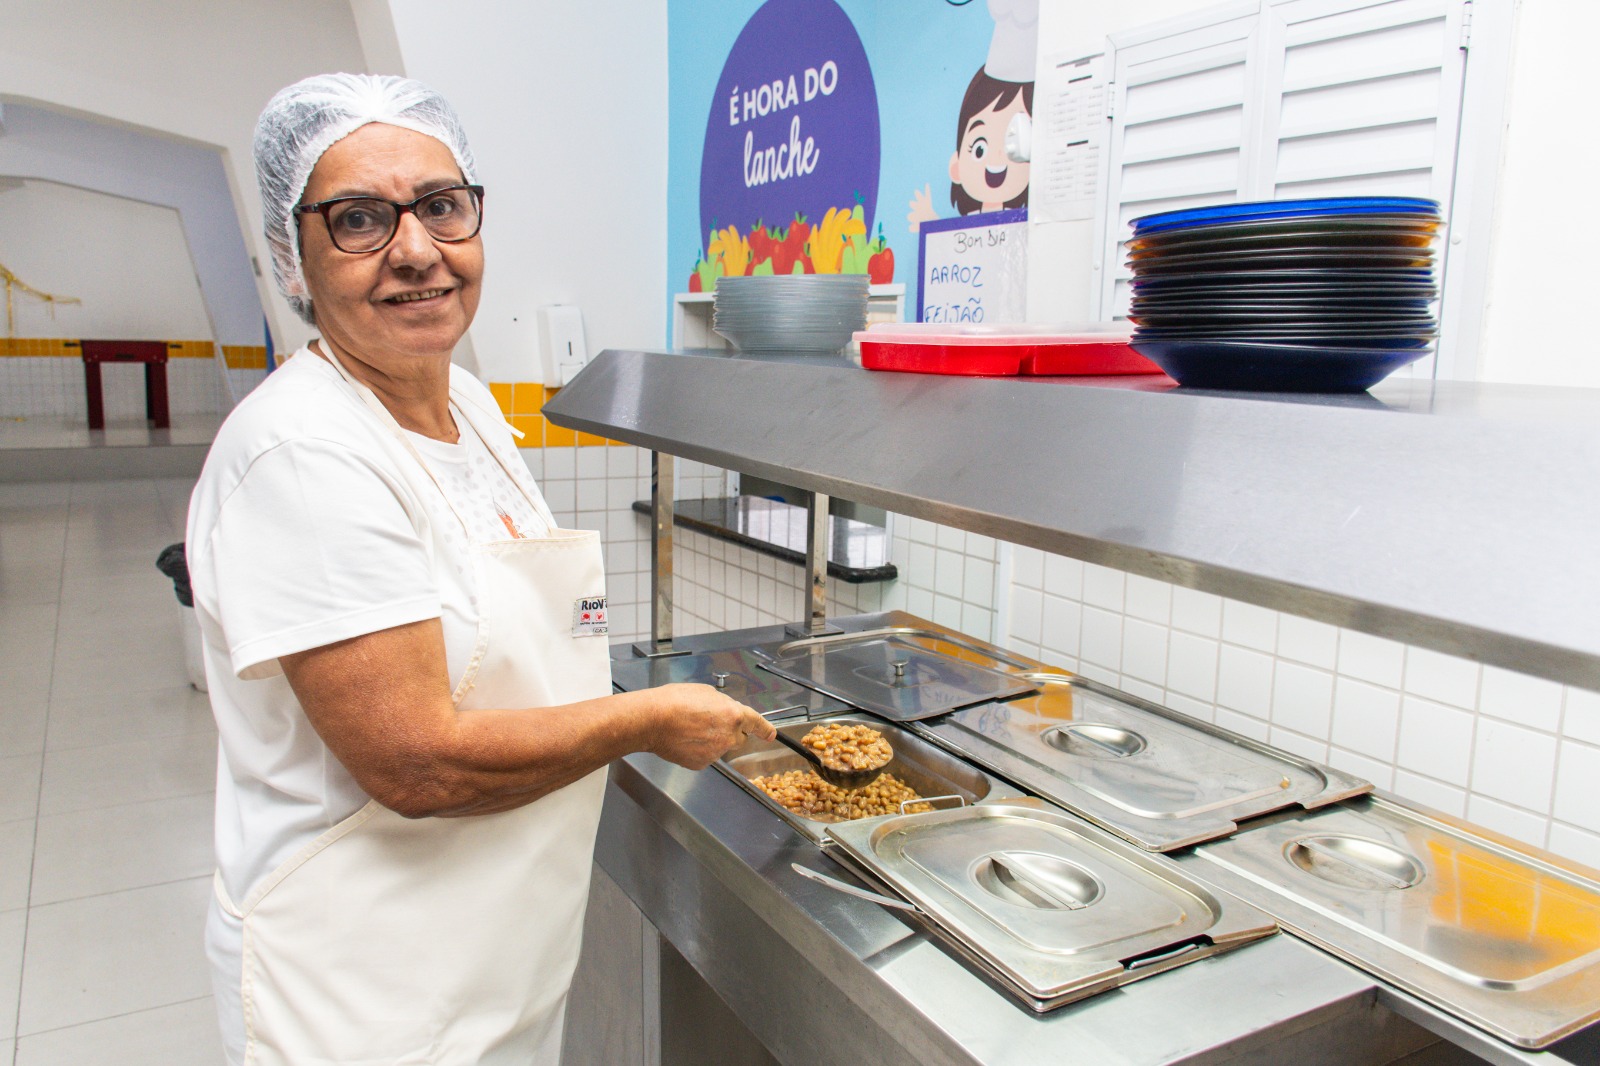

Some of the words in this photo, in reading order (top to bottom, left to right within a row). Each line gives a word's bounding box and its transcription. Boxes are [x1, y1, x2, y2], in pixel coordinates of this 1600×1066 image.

[730, 85, 740, 126] É
[743, 74, 799, 122] HORA
[804, 60, 838, 102] DO
[743, 115, 820, 188] lanche
[930, 264, 983, 288] ARROZ
